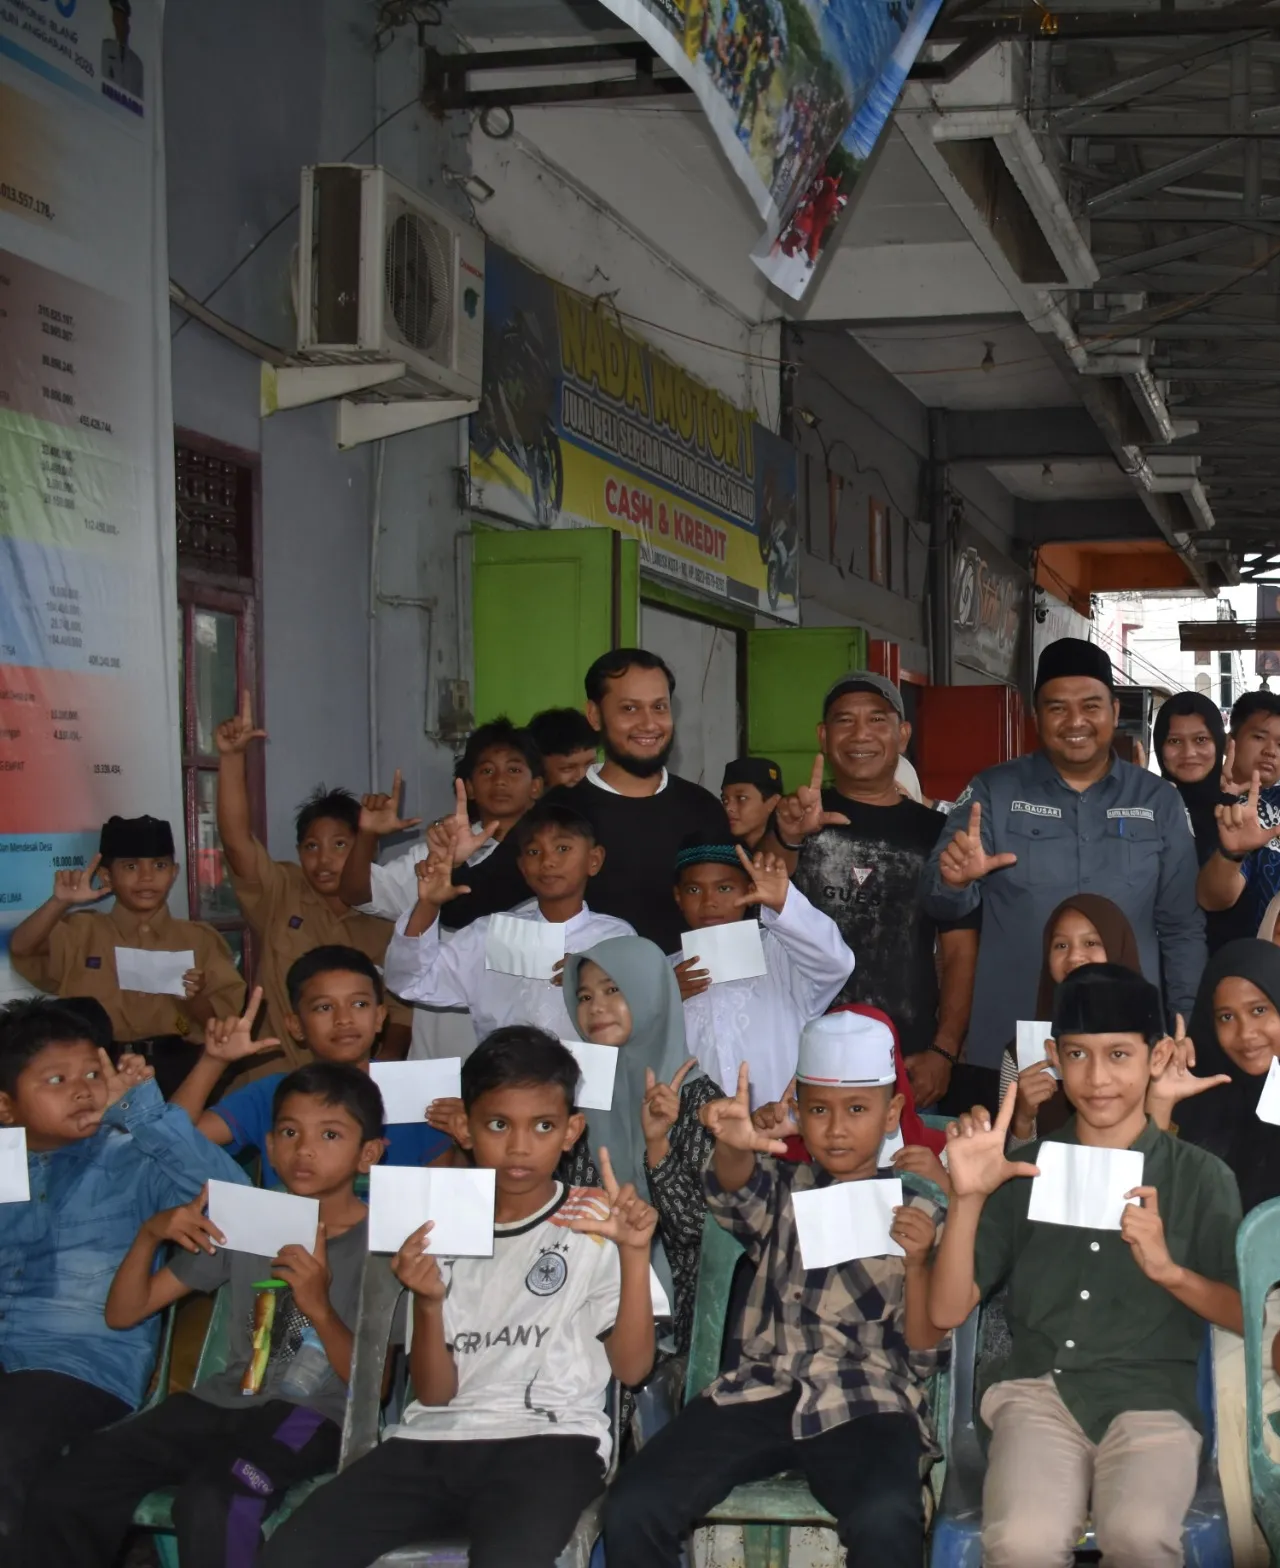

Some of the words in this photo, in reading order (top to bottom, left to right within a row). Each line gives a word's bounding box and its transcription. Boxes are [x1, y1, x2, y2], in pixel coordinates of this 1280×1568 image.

[557, 287, 649, 418] NADA
[651, 350, 740, 471] MOTOR
[563, 385, 592, 434] JUAL
[592, 403, 619, 454] BELI
[619, 418, 660, 472] SEPEDA
[660, 440, 698, 490] MOTOR
[605, 478, 653, 530] CASH
[658, 503, 670, 535] &
[673, 508, 727, 561] KREDIT
